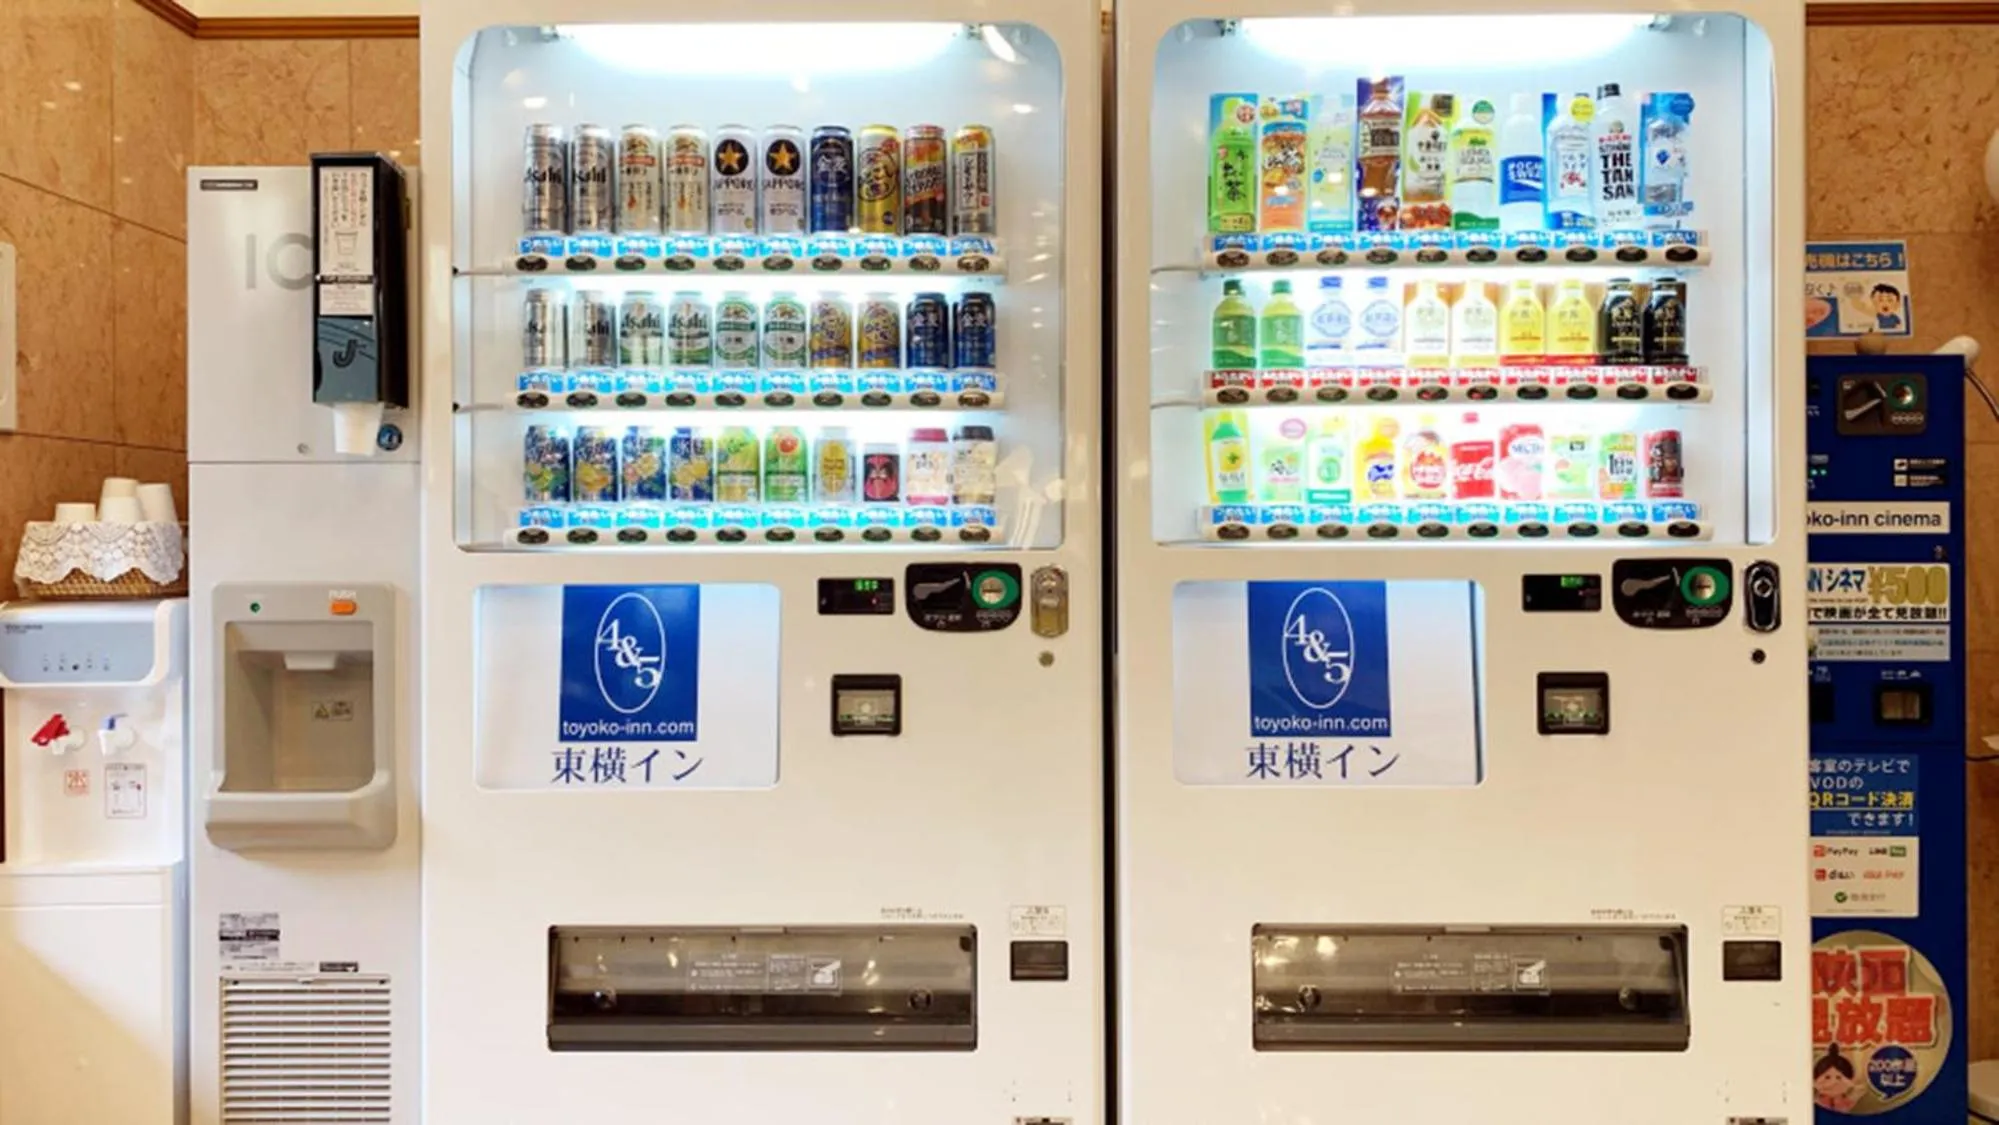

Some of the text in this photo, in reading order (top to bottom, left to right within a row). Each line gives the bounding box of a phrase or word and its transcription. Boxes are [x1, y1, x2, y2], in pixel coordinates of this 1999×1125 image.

[1601, 153, 1632, 169] THE
[1874, 510, 1941, 527] cinema
[1808, 606, 1947, 619] で映画が全て見放題!!
[562, 719, 694, 739] toyoko-inn.com
[1254, 715, 1389, 734] toyoko-inn.com
[550, 746, 704, 784] 東横イン
[1245, 742, 1401, 780] 東横イン
